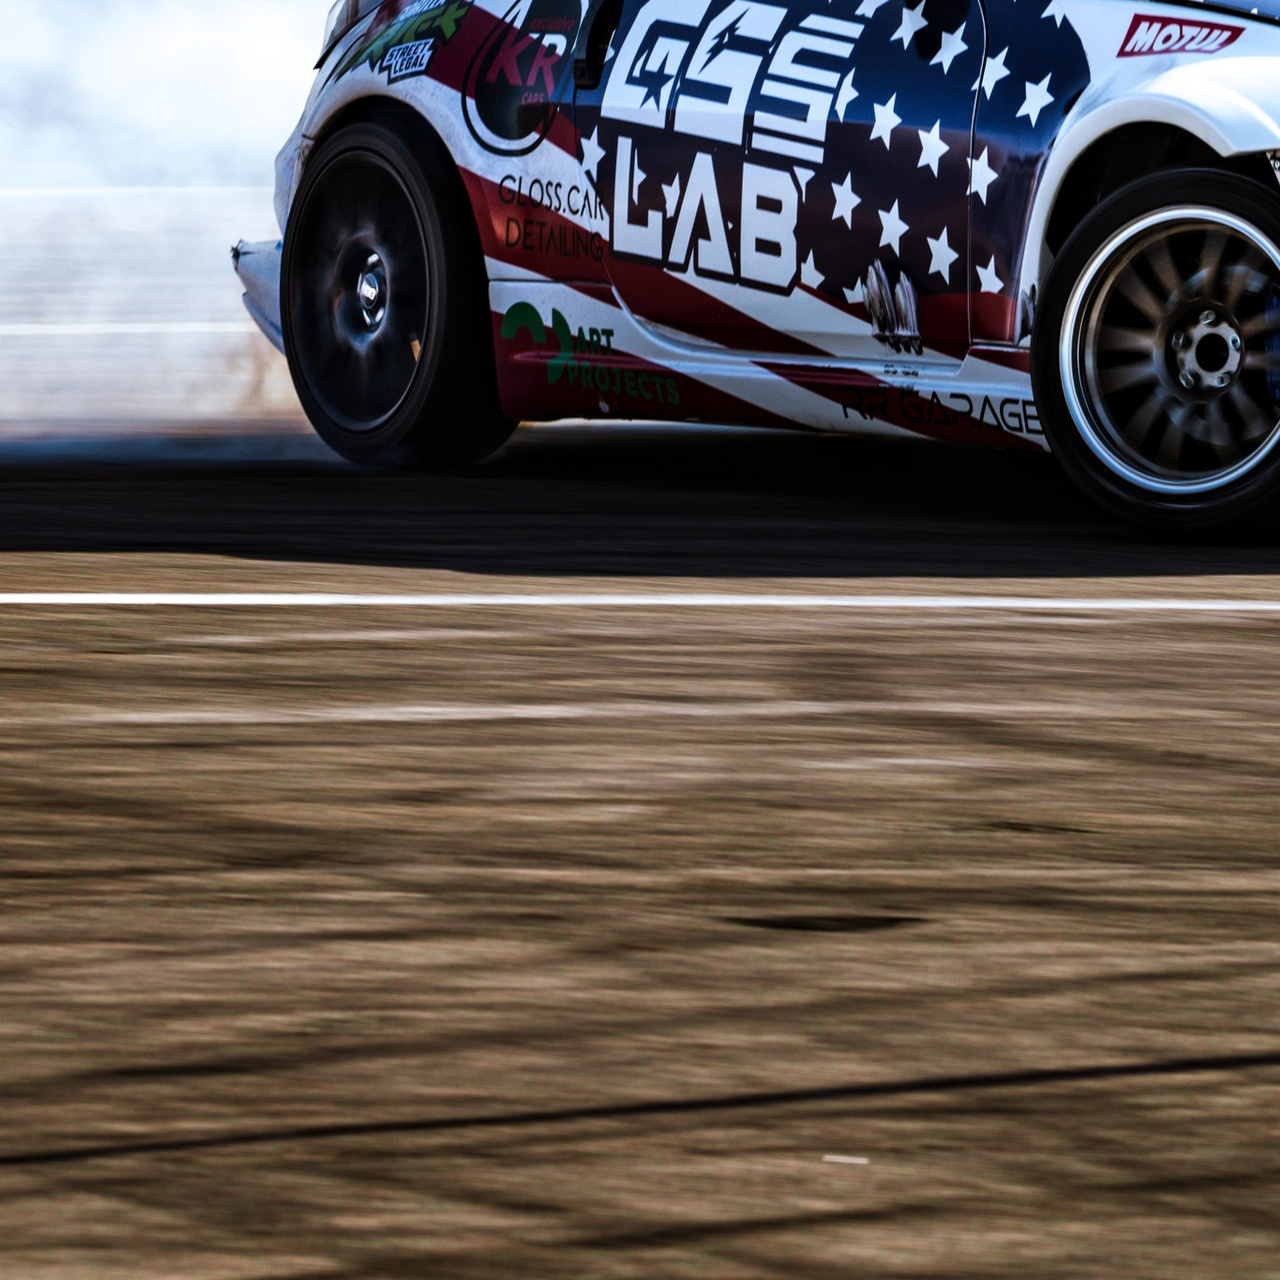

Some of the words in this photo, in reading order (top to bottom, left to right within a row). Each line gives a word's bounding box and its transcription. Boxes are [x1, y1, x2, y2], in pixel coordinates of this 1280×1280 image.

[386, 41, 431, 63] STREET
[1123, 21, 1232, 52] MOTUL
[393, 53, 425, 75] LEGAL
[485, 33, 568, 92] KR
[522, 92, 544, 106] CARS
[499, 174, 604, 221] GLOSS.CAR
[613, 136, 799, 289] LAB
[505, 216, 604, 262] DETAILING
[575, 326, 614, 356] ART
[566, 360, 681, 405] PROJECTS
[901, 390, 1044, 435] GARAGE
